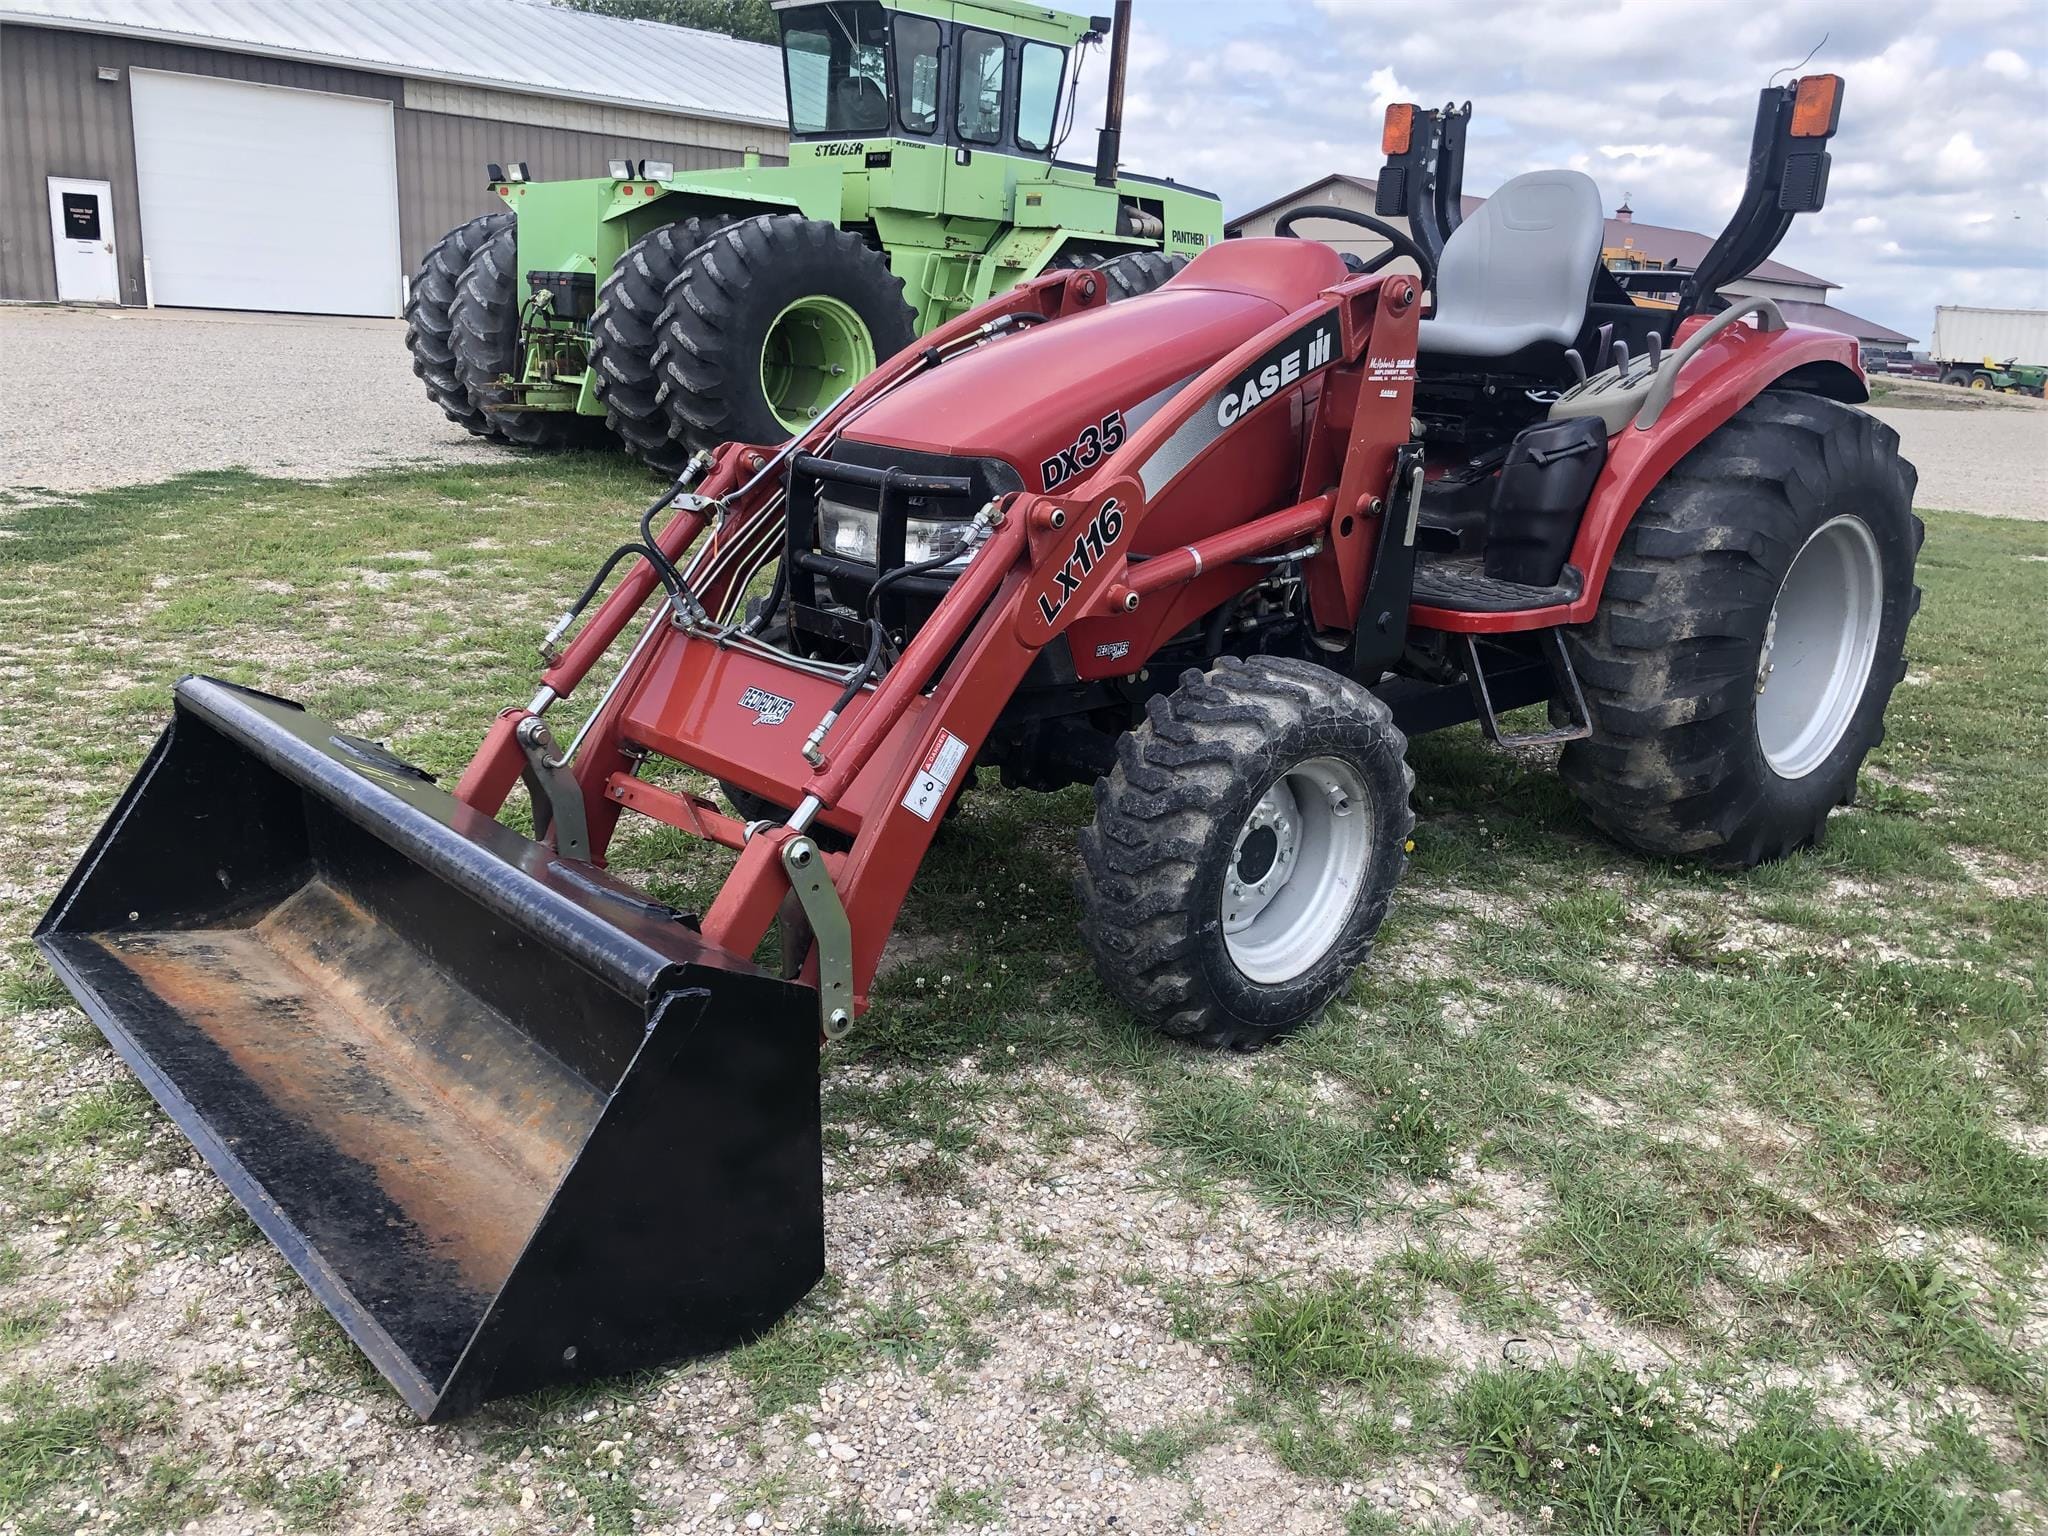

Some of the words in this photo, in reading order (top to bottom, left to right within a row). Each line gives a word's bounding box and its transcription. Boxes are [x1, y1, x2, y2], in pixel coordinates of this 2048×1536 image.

[815, 143, 864, 157] STEIGER
[1172, 230, 1204, 246] PANTHER
[1217, 349, 1300, 428] CASE
[1040, 409, 1127, 493] DX35
[1038, 497, 1124, 625] LX116
[757, 692, 795, 719] POWER
[929, 732, 948, 762] DANGER
